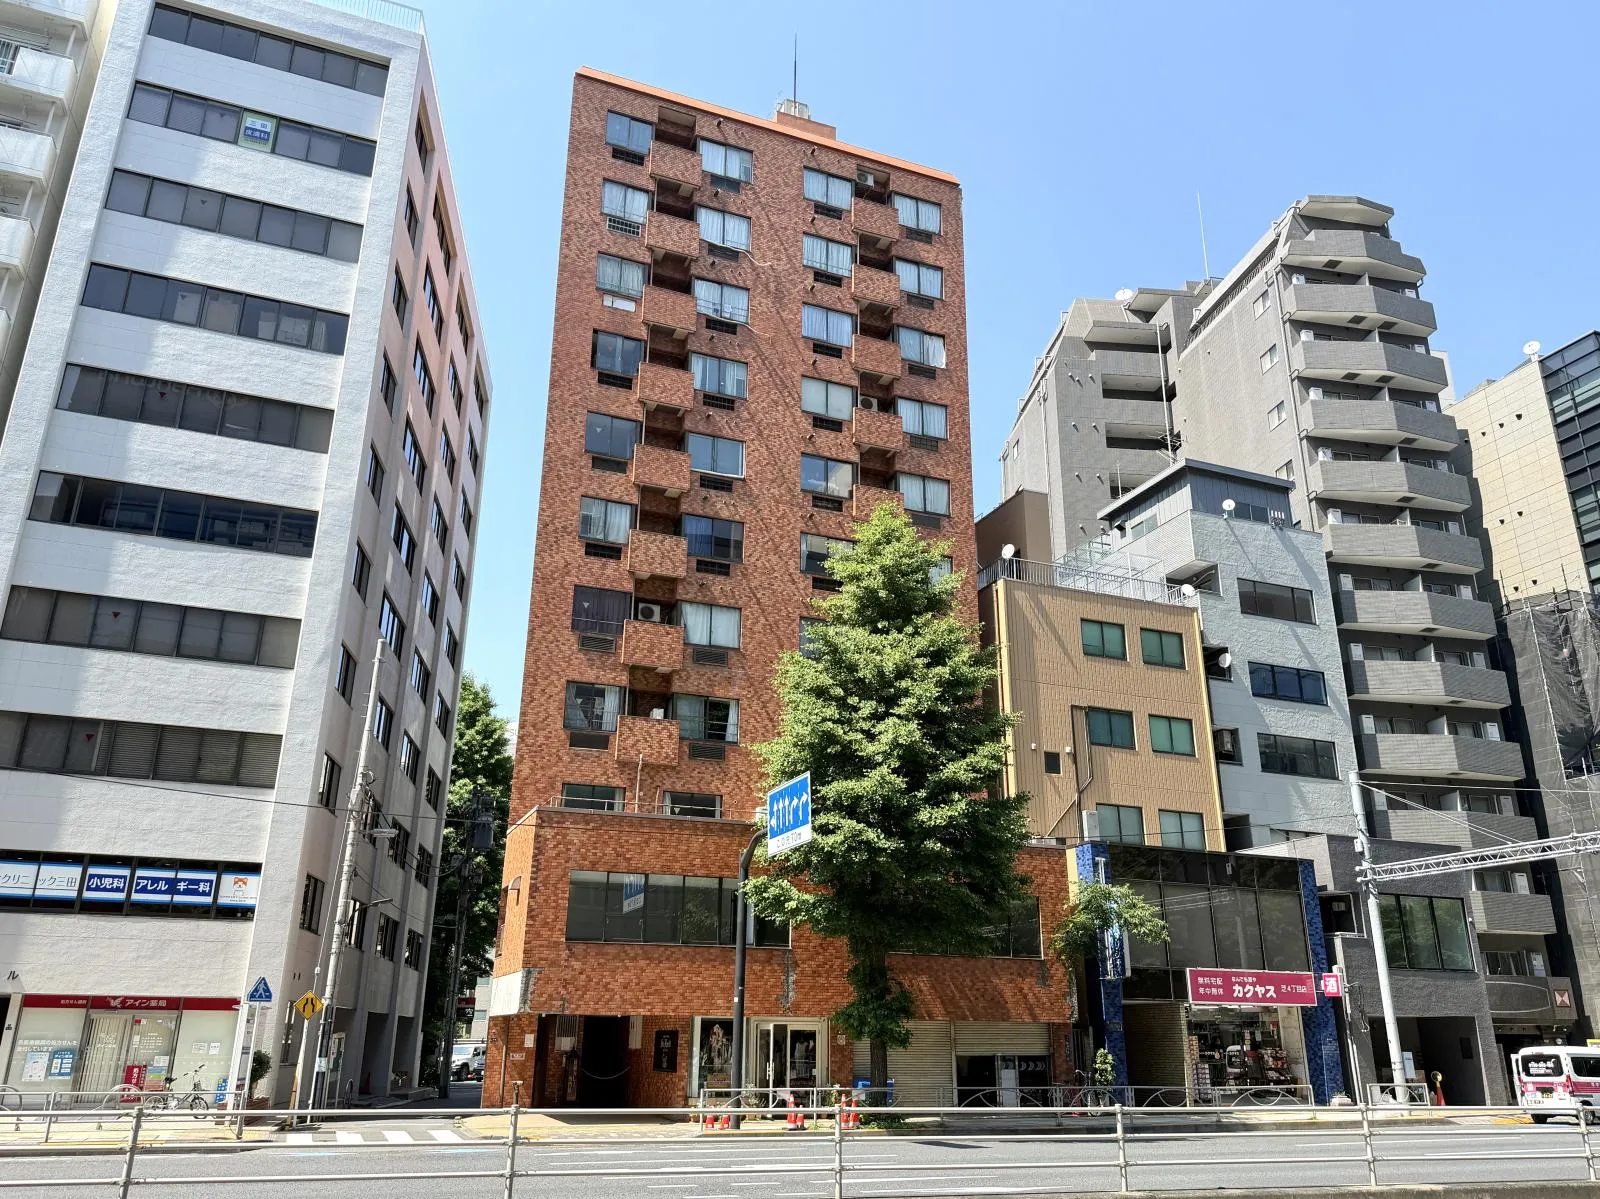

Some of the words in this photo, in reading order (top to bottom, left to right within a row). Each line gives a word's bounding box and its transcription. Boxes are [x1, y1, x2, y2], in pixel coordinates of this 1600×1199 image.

[0, 873, 77, 888] クリニック三田
[88, 876, 125, 890] 小児科
[136, 879, 210, 893] アレルギー科
[1197, 976, 1224, 985] 無料宅配
[1325, 977, 1338, 993] 酒
[1199, 987, 1225, 996] 年中無休
[1232, 983, 1277, 998] カクヤス
[1280, 984, 1308, 993] 芝4丁目店
[125, 999, 167, 1007] アイン薬局
